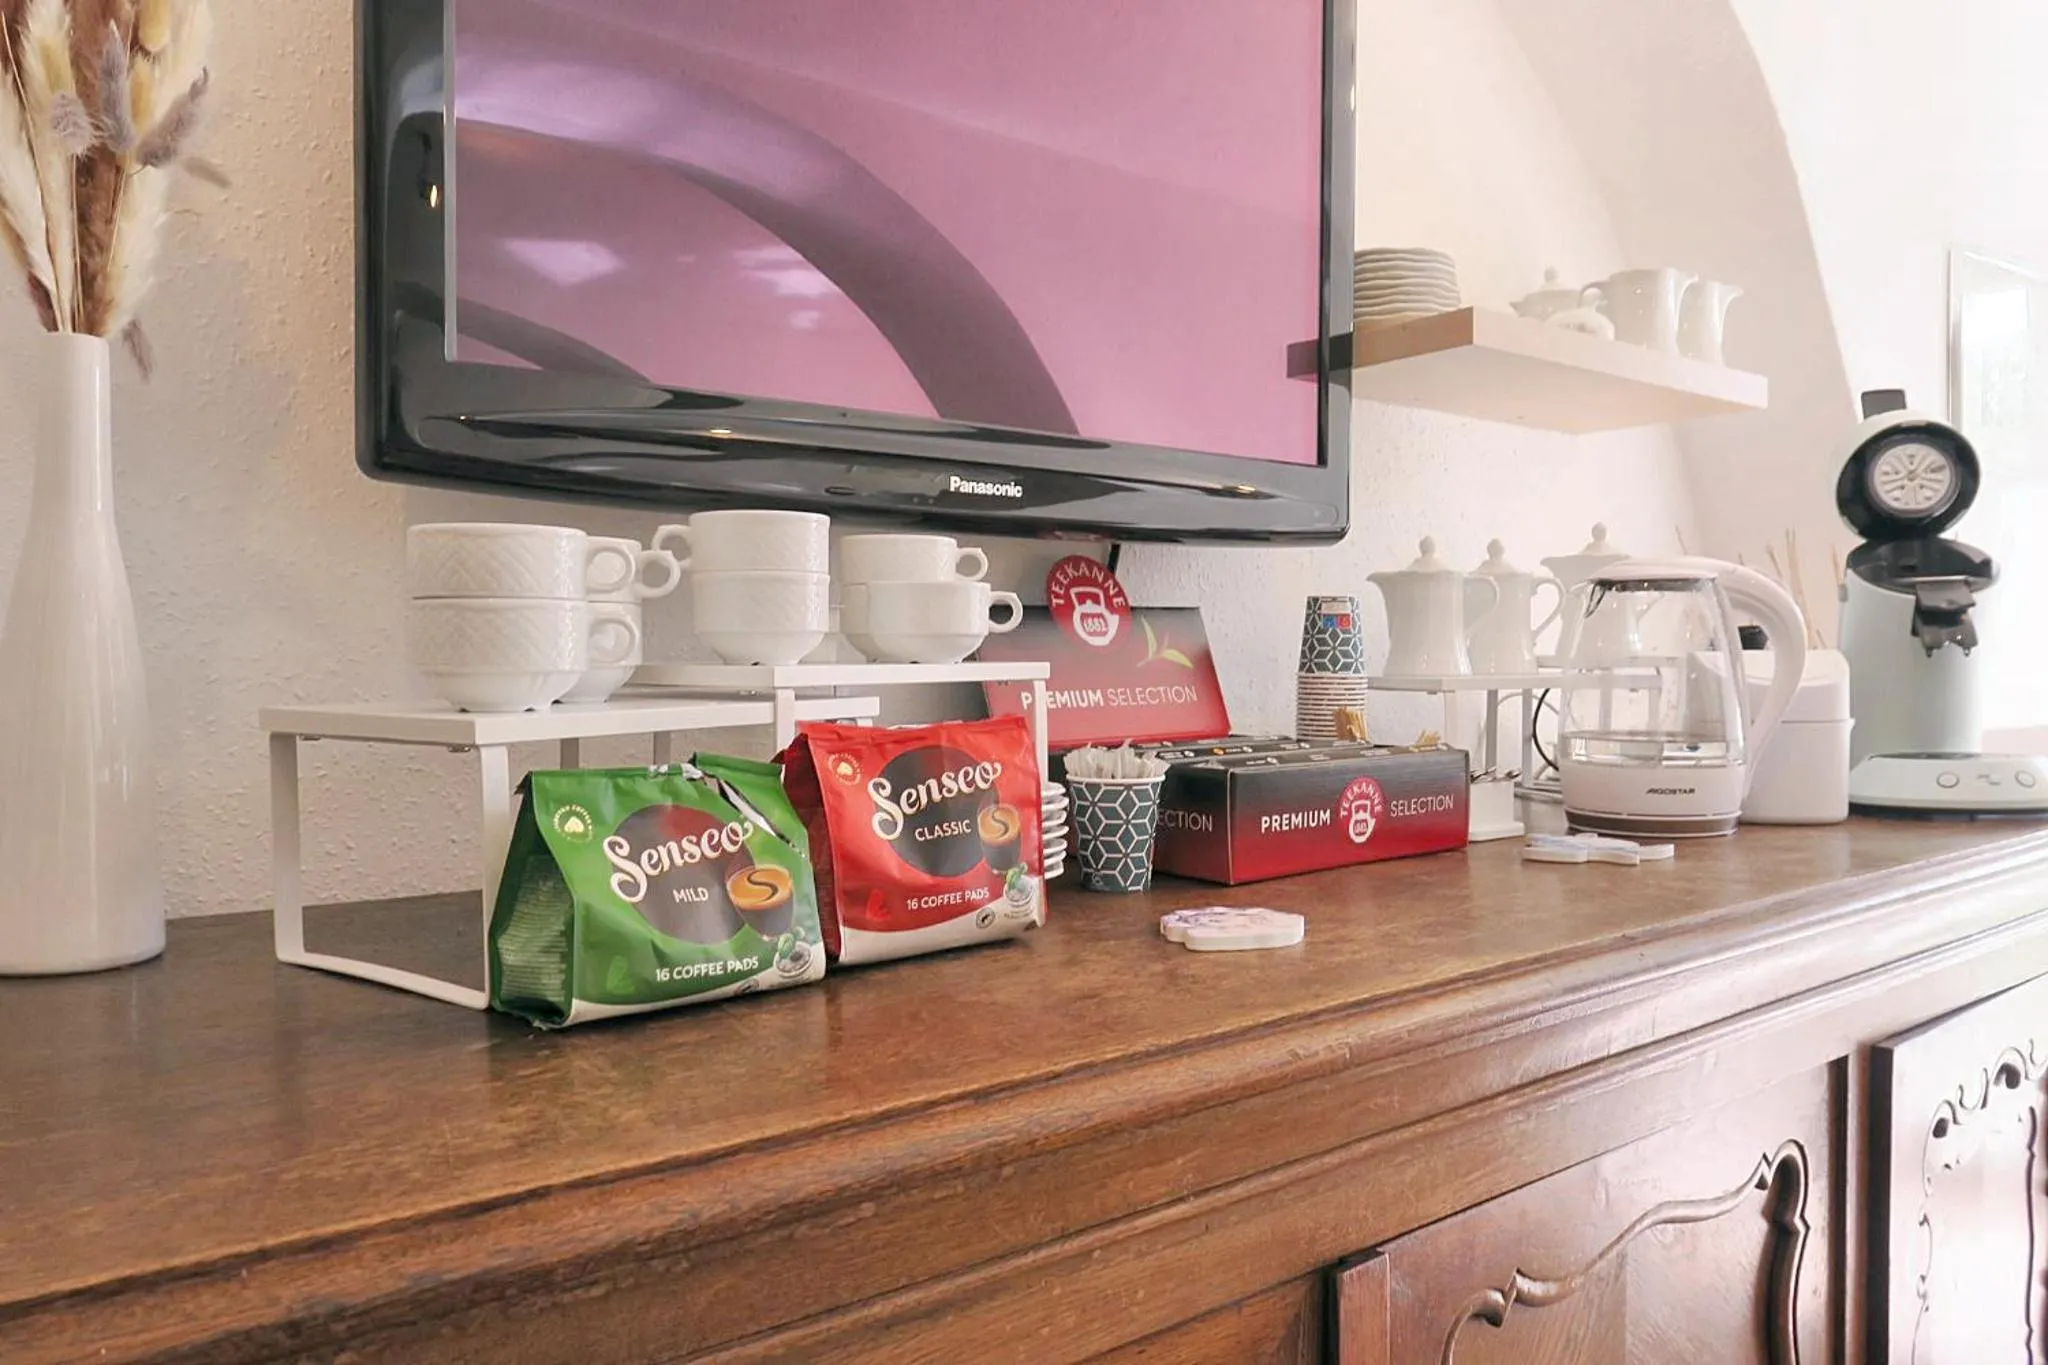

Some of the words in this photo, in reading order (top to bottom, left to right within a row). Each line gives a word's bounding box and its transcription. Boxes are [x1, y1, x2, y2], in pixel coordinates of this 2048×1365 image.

[949, 476, 1023, 497] Panasonic
[1051, 561, 1126, 609] TEEKANNE
[1020, 689, 1105, 711] PEMIUM
[1106, 685, 1199, 708] SELECTION
[868, 761, 1002, 841] Senseo
[1340, 781, 1383, 820] TEEKANNE
[1261, 808, 1331, 834] PREMIUM
[1390, 794, 1455, 818] SELECTION
[915, 820, 972, 842] CLASSIC
[603, 817, 754, 904] Senseo
[672, 887, 709, 903] MILD
[906, 898, 919, 911] 16
[920, 891, 963, 909] COFFEE
[964, 886, 990, 902] PADS
[656, 967, 670, 982] 16
[672, 961, 725, 980] COFFEE
[727, 956, 759, 973] PADS
